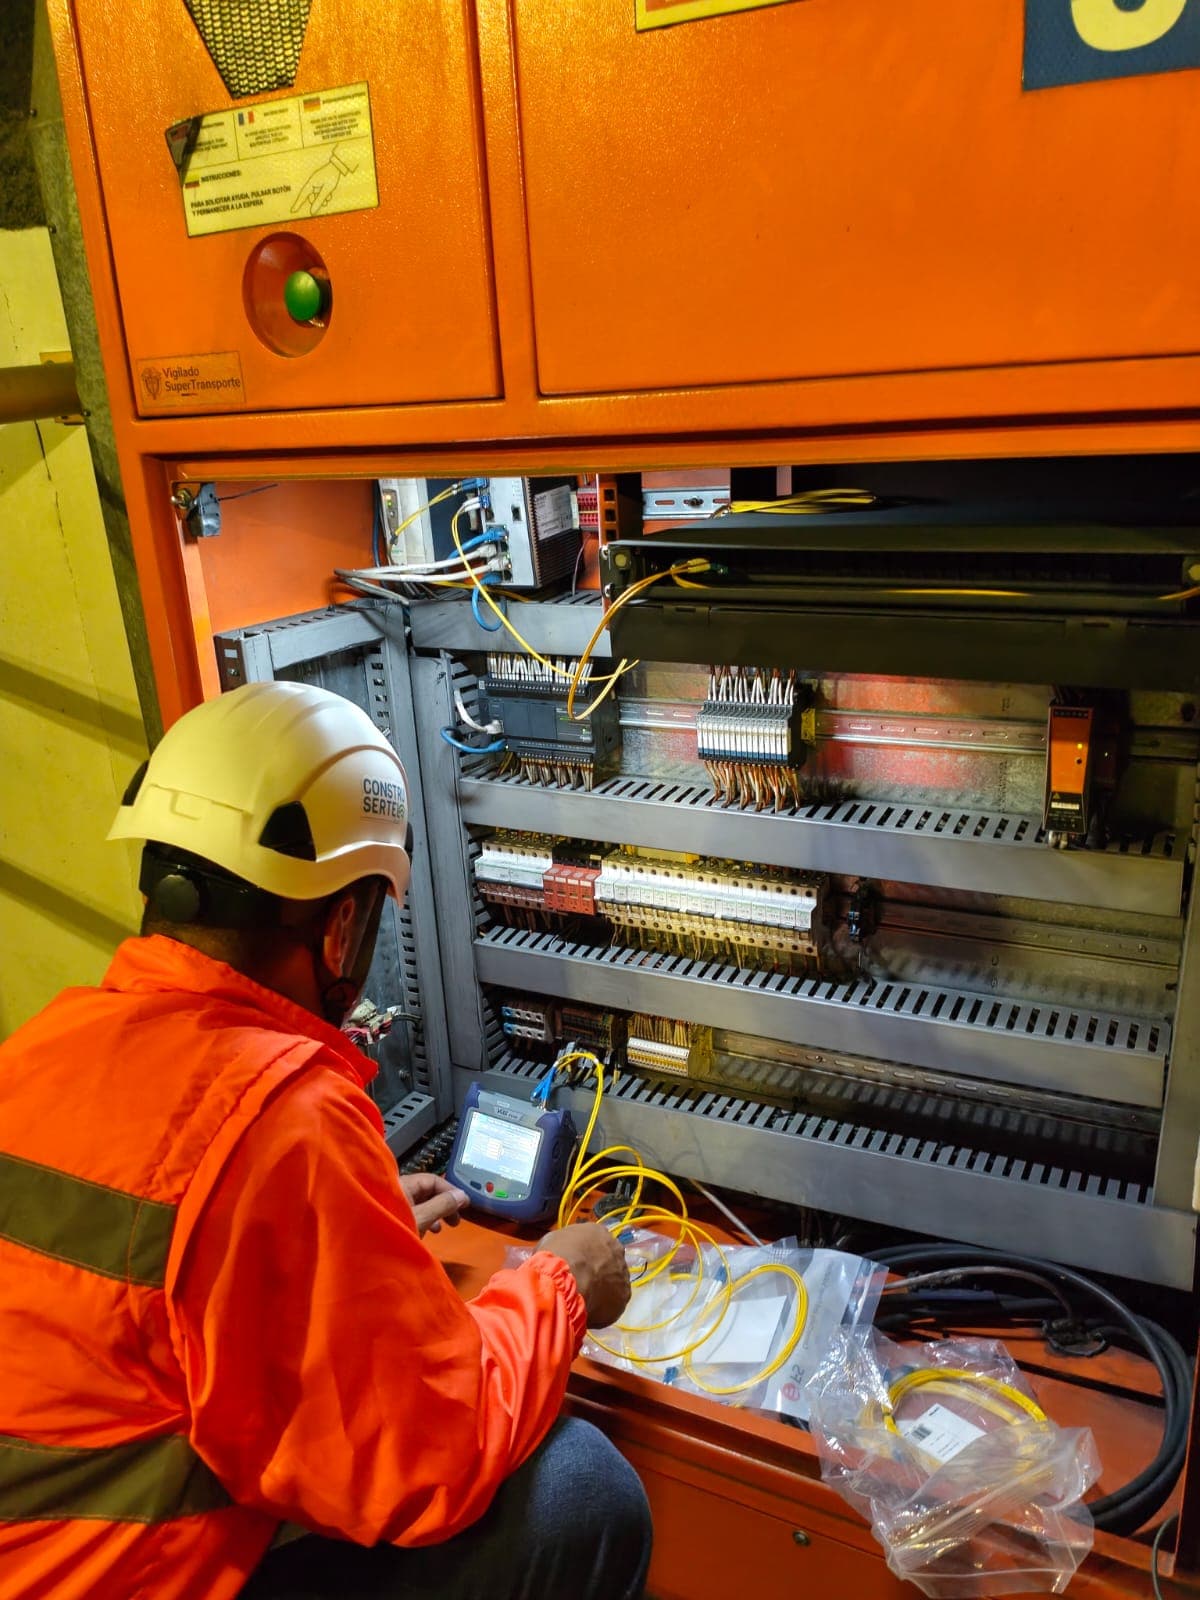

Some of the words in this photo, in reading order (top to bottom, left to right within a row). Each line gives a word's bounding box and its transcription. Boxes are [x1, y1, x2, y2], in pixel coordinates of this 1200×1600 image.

[191, 200, 205, 209] PARA
[197, 204, 230, 216] PERMANECER
[243, 198, 264, 208] ESPERA
[162, 367, 200, 380] Vigilado
[164, 378, 241, 392] SuperTransporte
